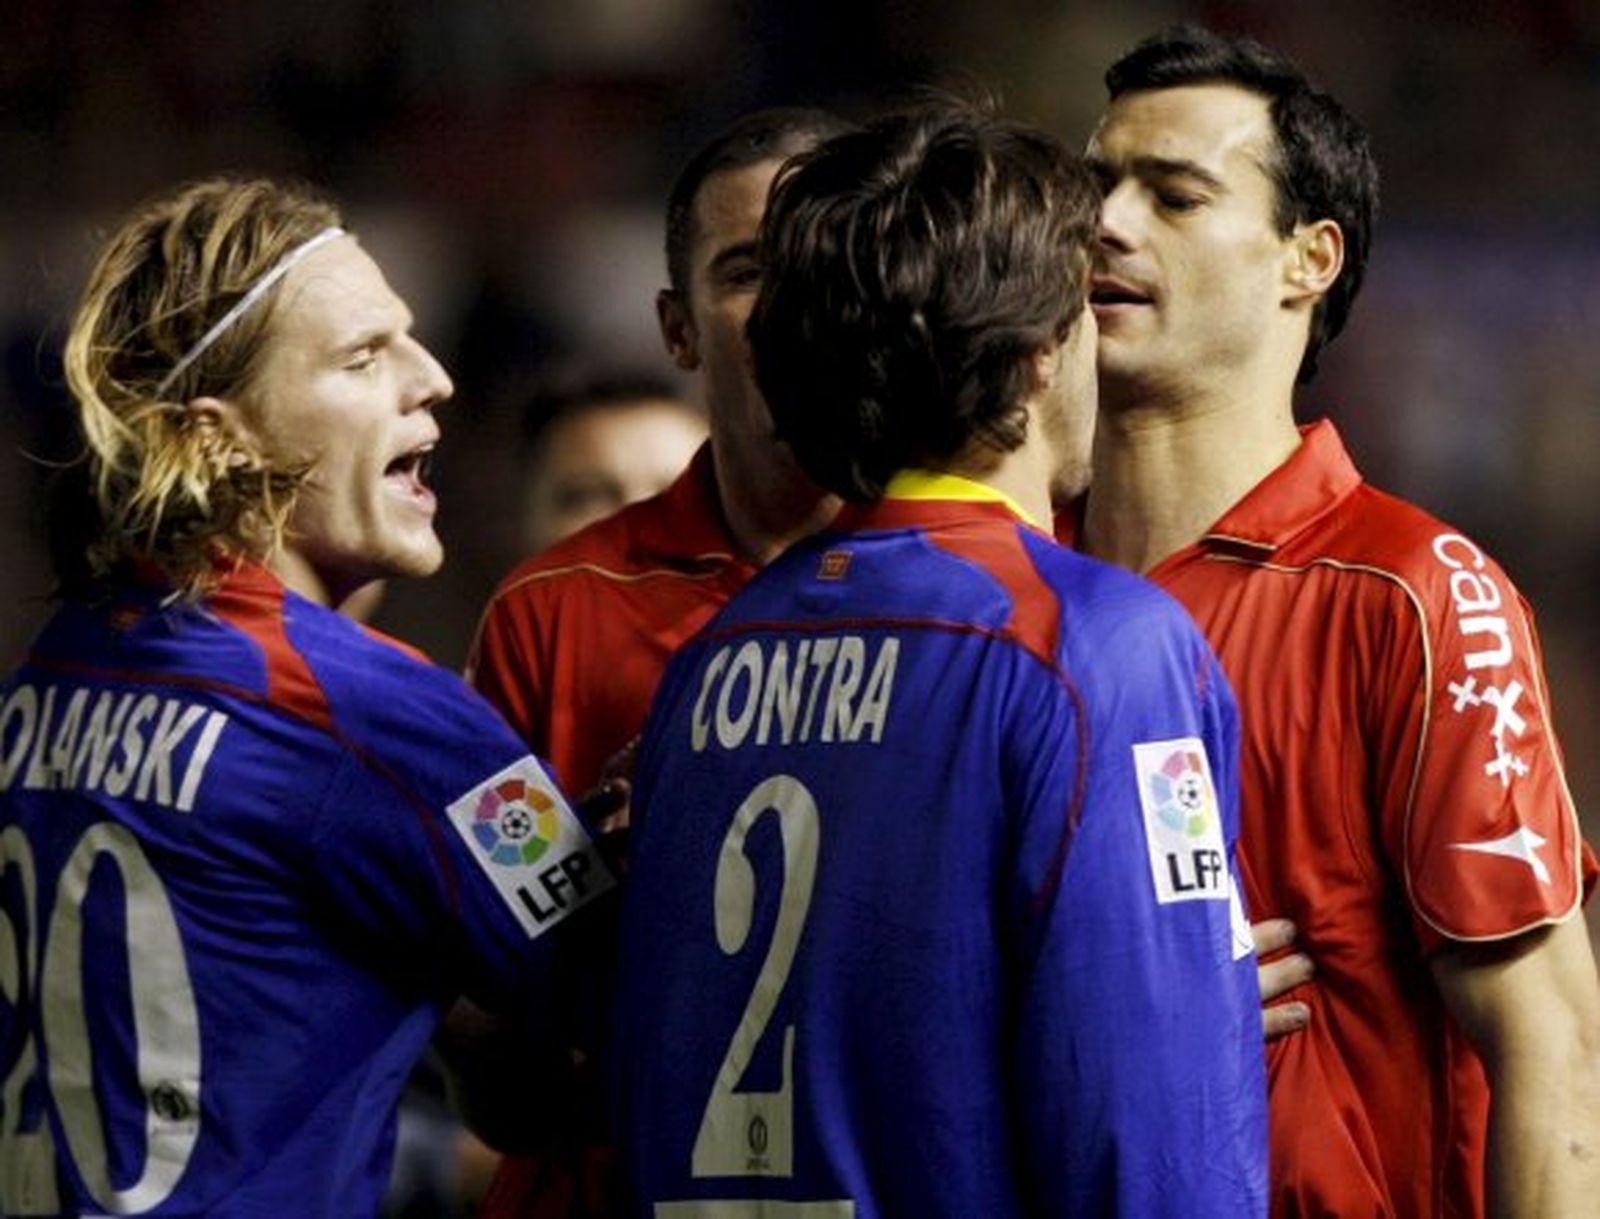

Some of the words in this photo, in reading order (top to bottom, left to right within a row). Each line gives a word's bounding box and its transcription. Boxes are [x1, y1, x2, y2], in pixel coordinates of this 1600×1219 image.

[0, 684, 229, 812] OLANSKI
[691, 636, 900, 752] CONTRA
[517, 851, 591, 924] LFP
[1166, 850, 1221, 892] LFP
[0, 822, 200, 1216] 20
[691, 774, 820, 1178] 2
